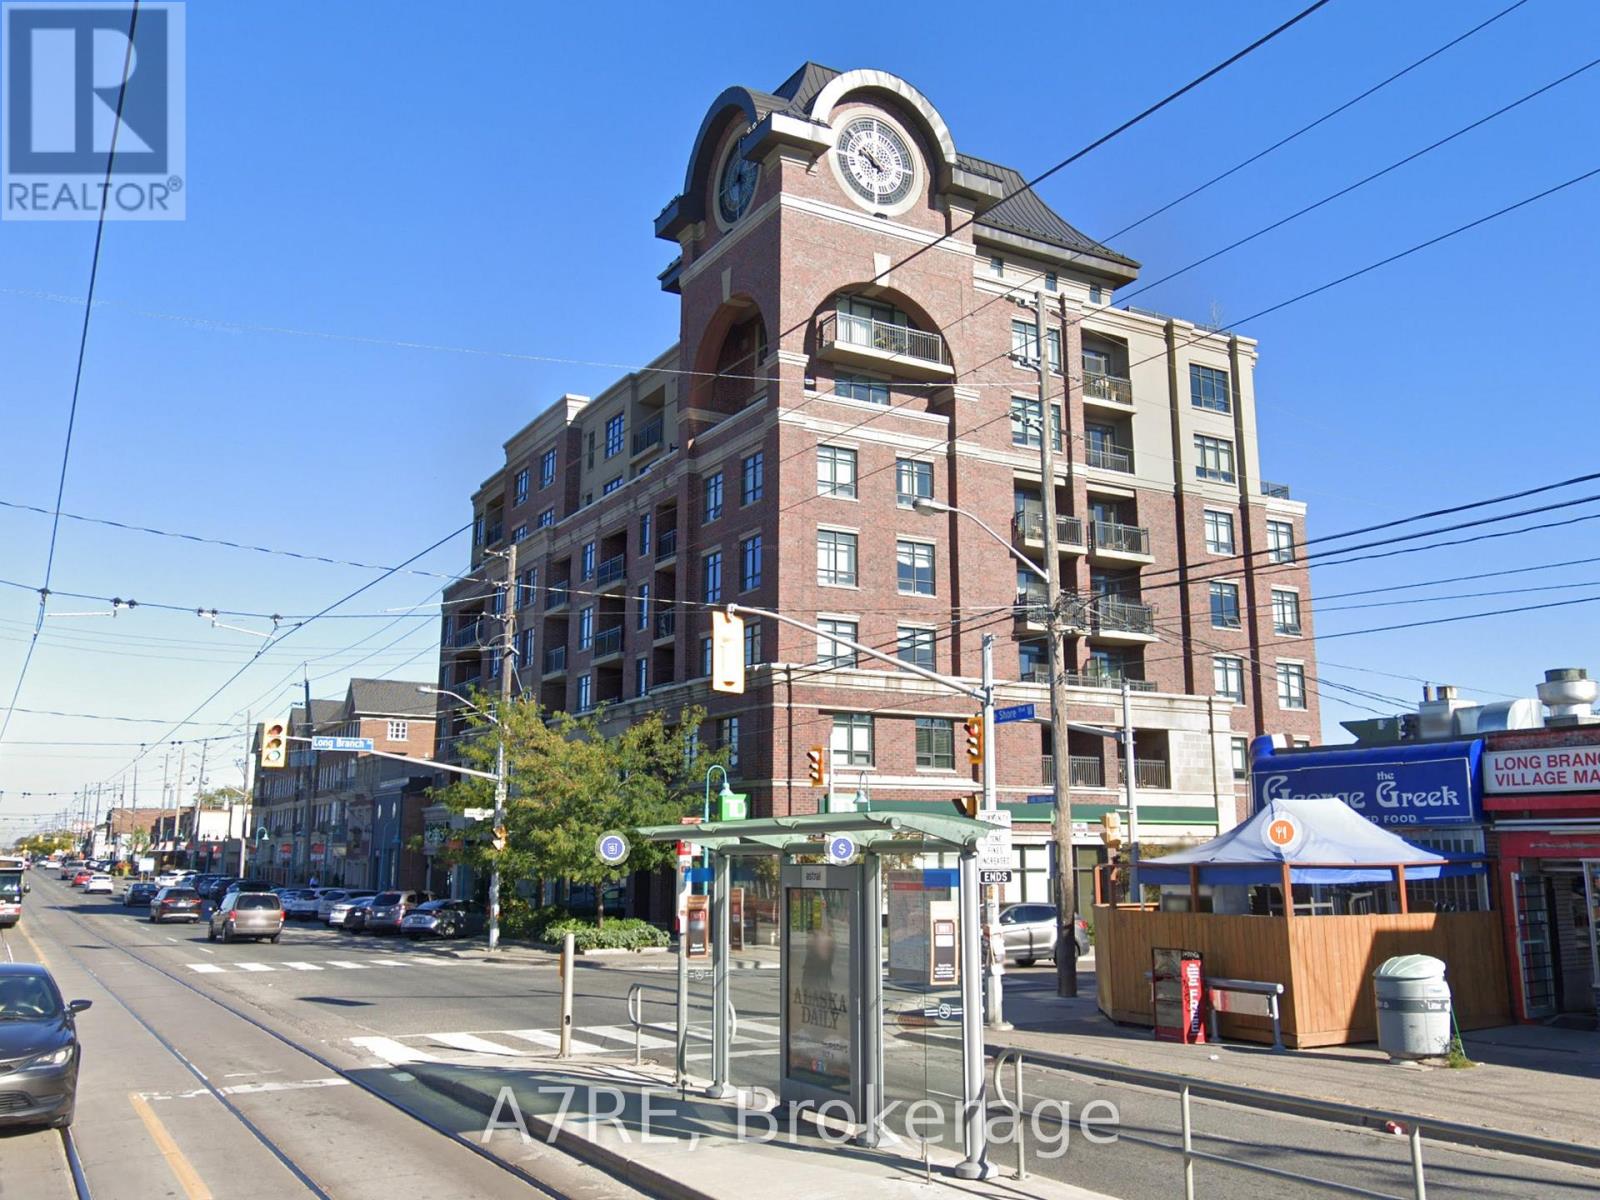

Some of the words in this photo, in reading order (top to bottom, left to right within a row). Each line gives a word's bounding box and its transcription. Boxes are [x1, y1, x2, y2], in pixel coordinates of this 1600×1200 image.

[999, 710, 1017, 720] Shore
[1026, 705, 1033, 716] W
[314, 738, 333, 749] Long
[336, 738, 365, 748] Branch
[1494, 755, 1541, 771] LONG
[1547, 752, 1600, 769] BRAN
[1377, 771, 1395, 781] the
[1495, 771, 1568, 787] VILLAGE
[1376, 781, 1460, 808] Greek
[1384, 814, 1417, 824] FOOD
[984, 872, 1008, 882] ENDS
[793, 988, 847, 1013] ALASKA
[801, 1006, 840, 1030] DAILY
